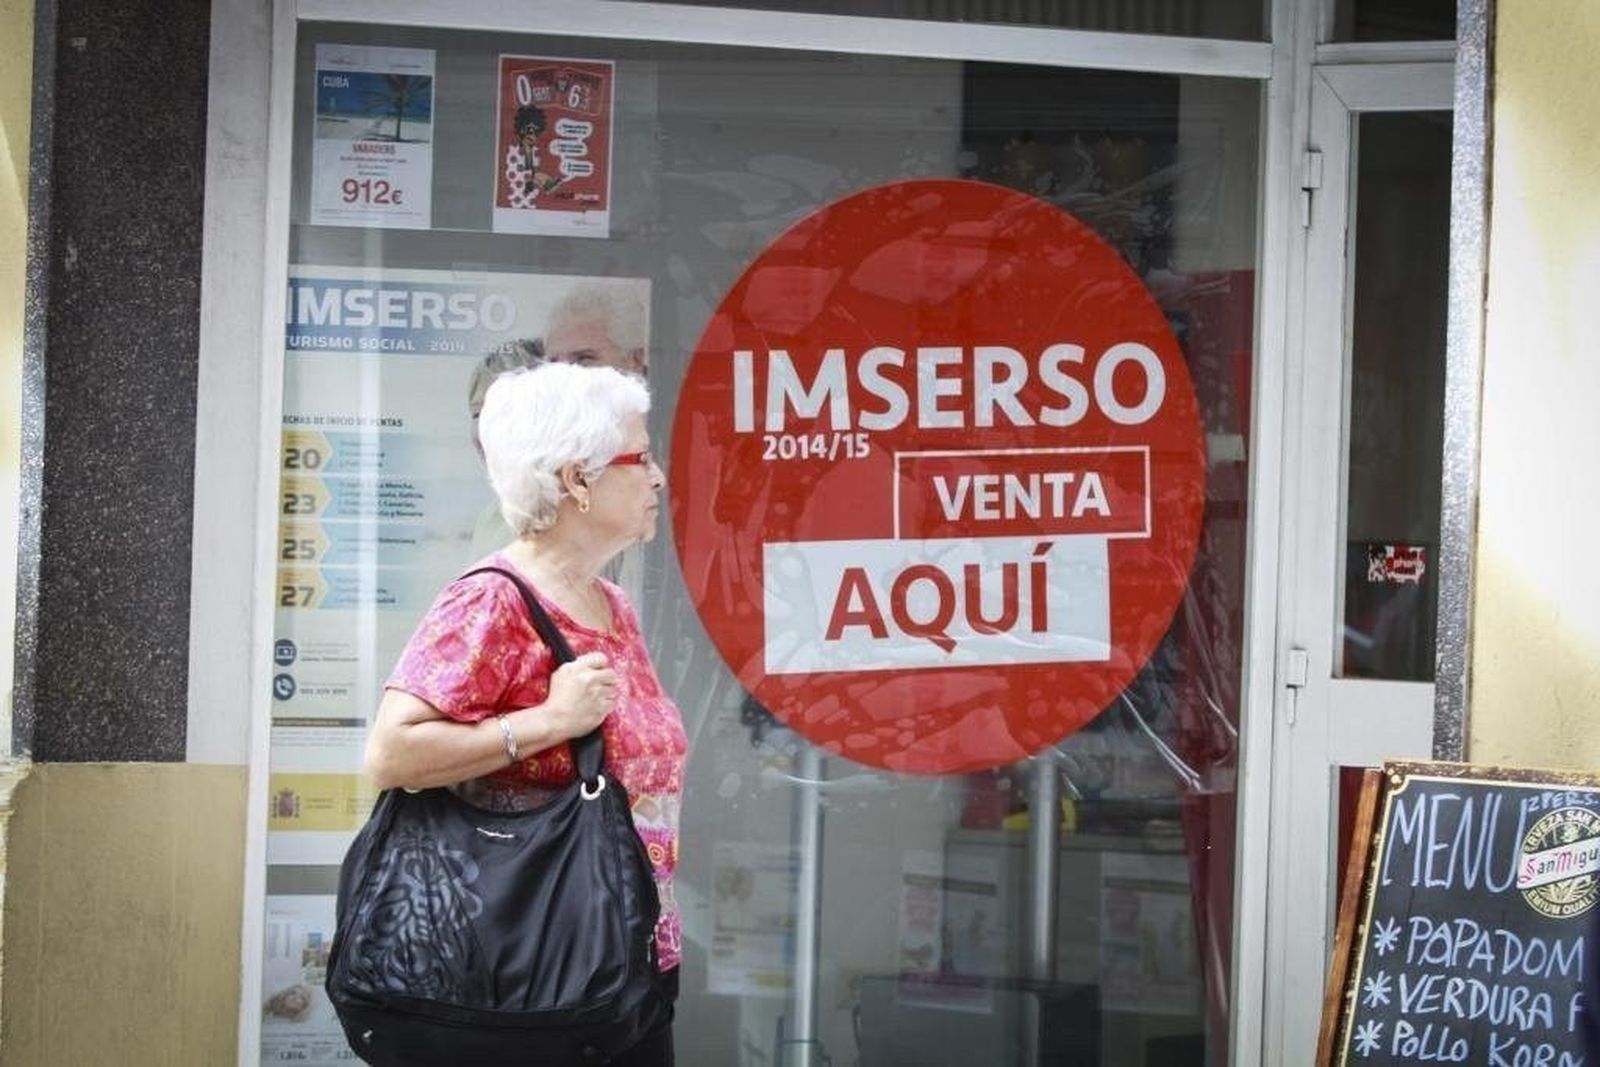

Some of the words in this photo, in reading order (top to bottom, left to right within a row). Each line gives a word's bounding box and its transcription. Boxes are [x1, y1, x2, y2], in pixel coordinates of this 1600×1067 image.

[285, 335, 353, 350] URISMO
[359, 337, 416, 351] SOCIAL
[732, 341, 1167, 433] IMSERSO
[284, 448, 321, 470] 20
[762, 432, 871, 461] 2014/15
[283, 493, 317, 515] 23
[933, 471, 1112, 522] VENTA
[282, 538, 316, 561] 25
[280, 585, 315, 608] 27
[824, 541, 1055, 654] AQUÍ
[1382, 792, 1527, 893] MENU
[1523, 812, 1564, 853] ERVEZA
[1399, 973, 1553, 1032] VERDURA
